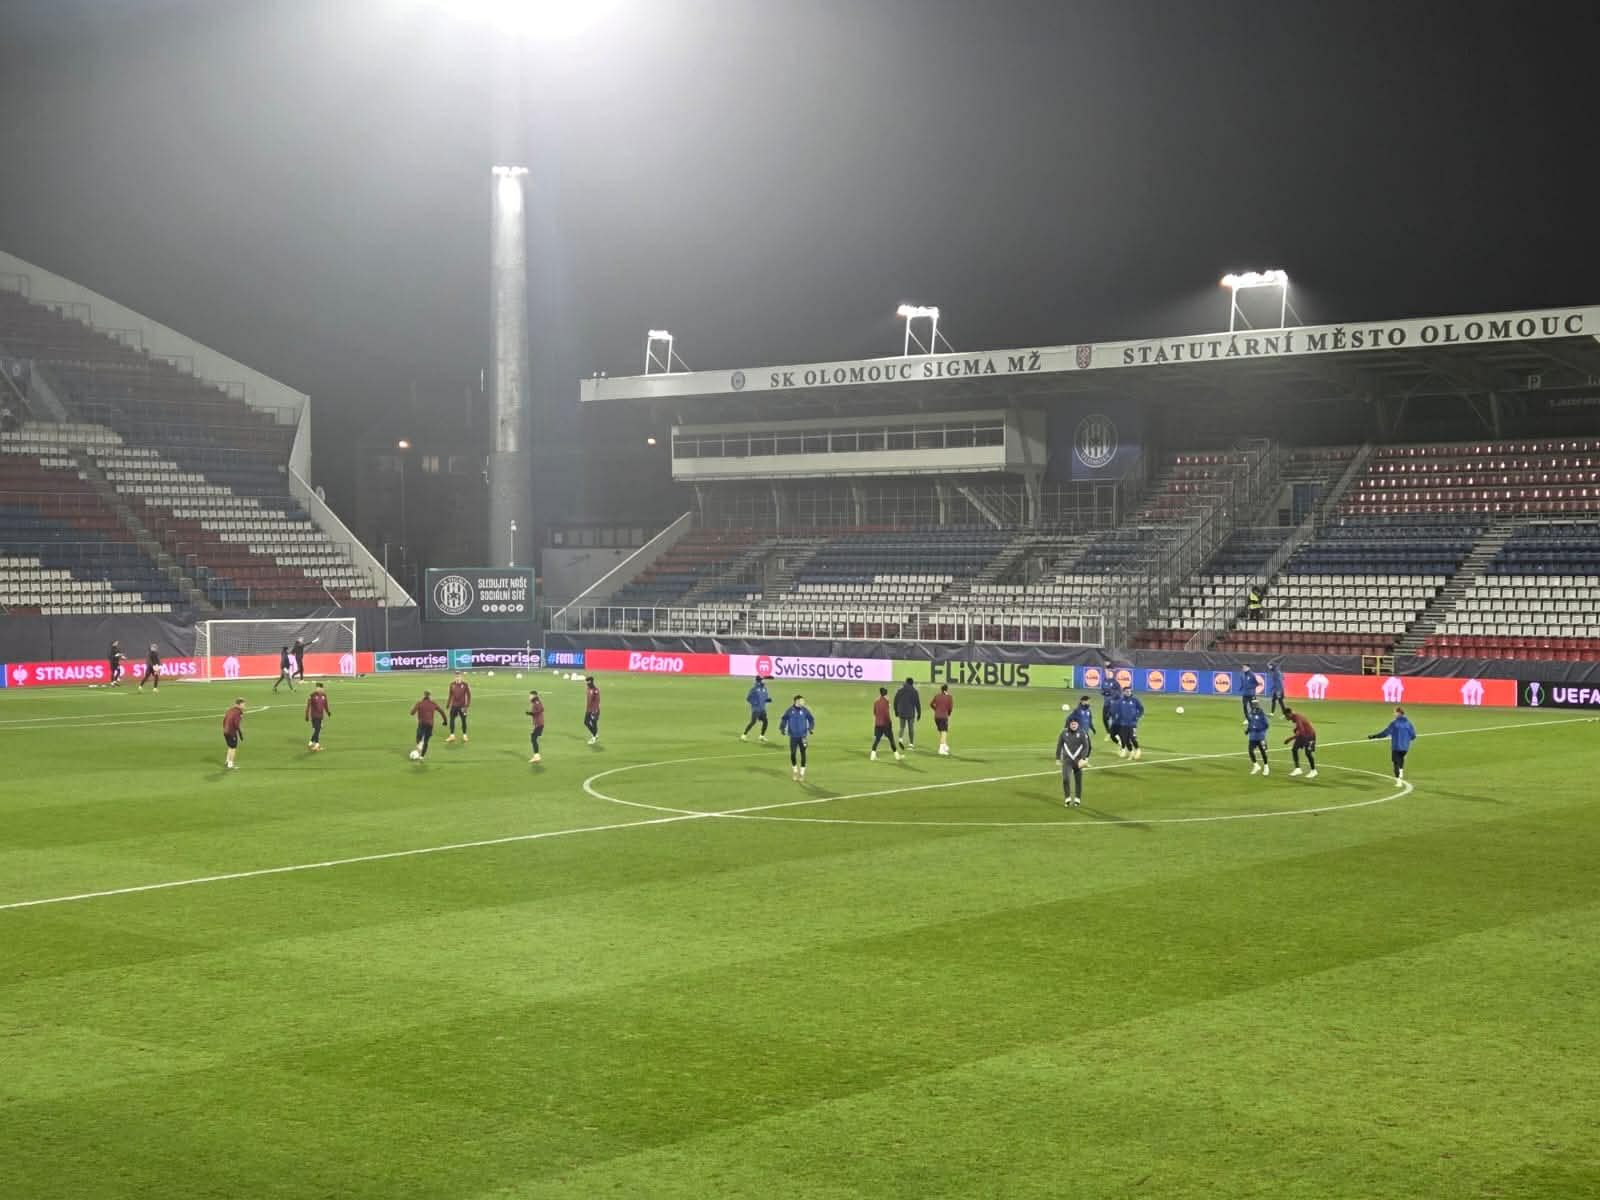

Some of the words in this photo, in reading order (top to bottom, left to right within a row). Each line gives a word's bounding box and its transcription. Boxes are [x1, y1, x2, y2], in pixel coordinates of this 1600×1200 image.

[1123, 331, 1293, 365] STATUTÁRNÍ
[1306, 327, 1407, 351] MĚSTO
[1420, 314, 1584, 344] OLOMOUC
[770, 372, 796, 388] SK
[803, 363, 913, 386] OLOMOUC
[922, 358, 997, 378] SIGMA
[1007, 350, 1041, 373] MŽ
[478, 578, 509, 589] SLEDUJTE
[510, 575, 528, 589] NAŠE
[480, 588, 511, 601] SOCIÁLNÍ
[379, 653, 447, 668] enterprise
[459, 651, 540, 665] enterprise
[629, 652, 684, 672] Betano
[35, 664, 104, 681] STRAUSS
[133, 661, 197, 677] STAUSS
[775, 658, 863, 679] Swissquote
[1553, 687, 1600, 704] UEFA
